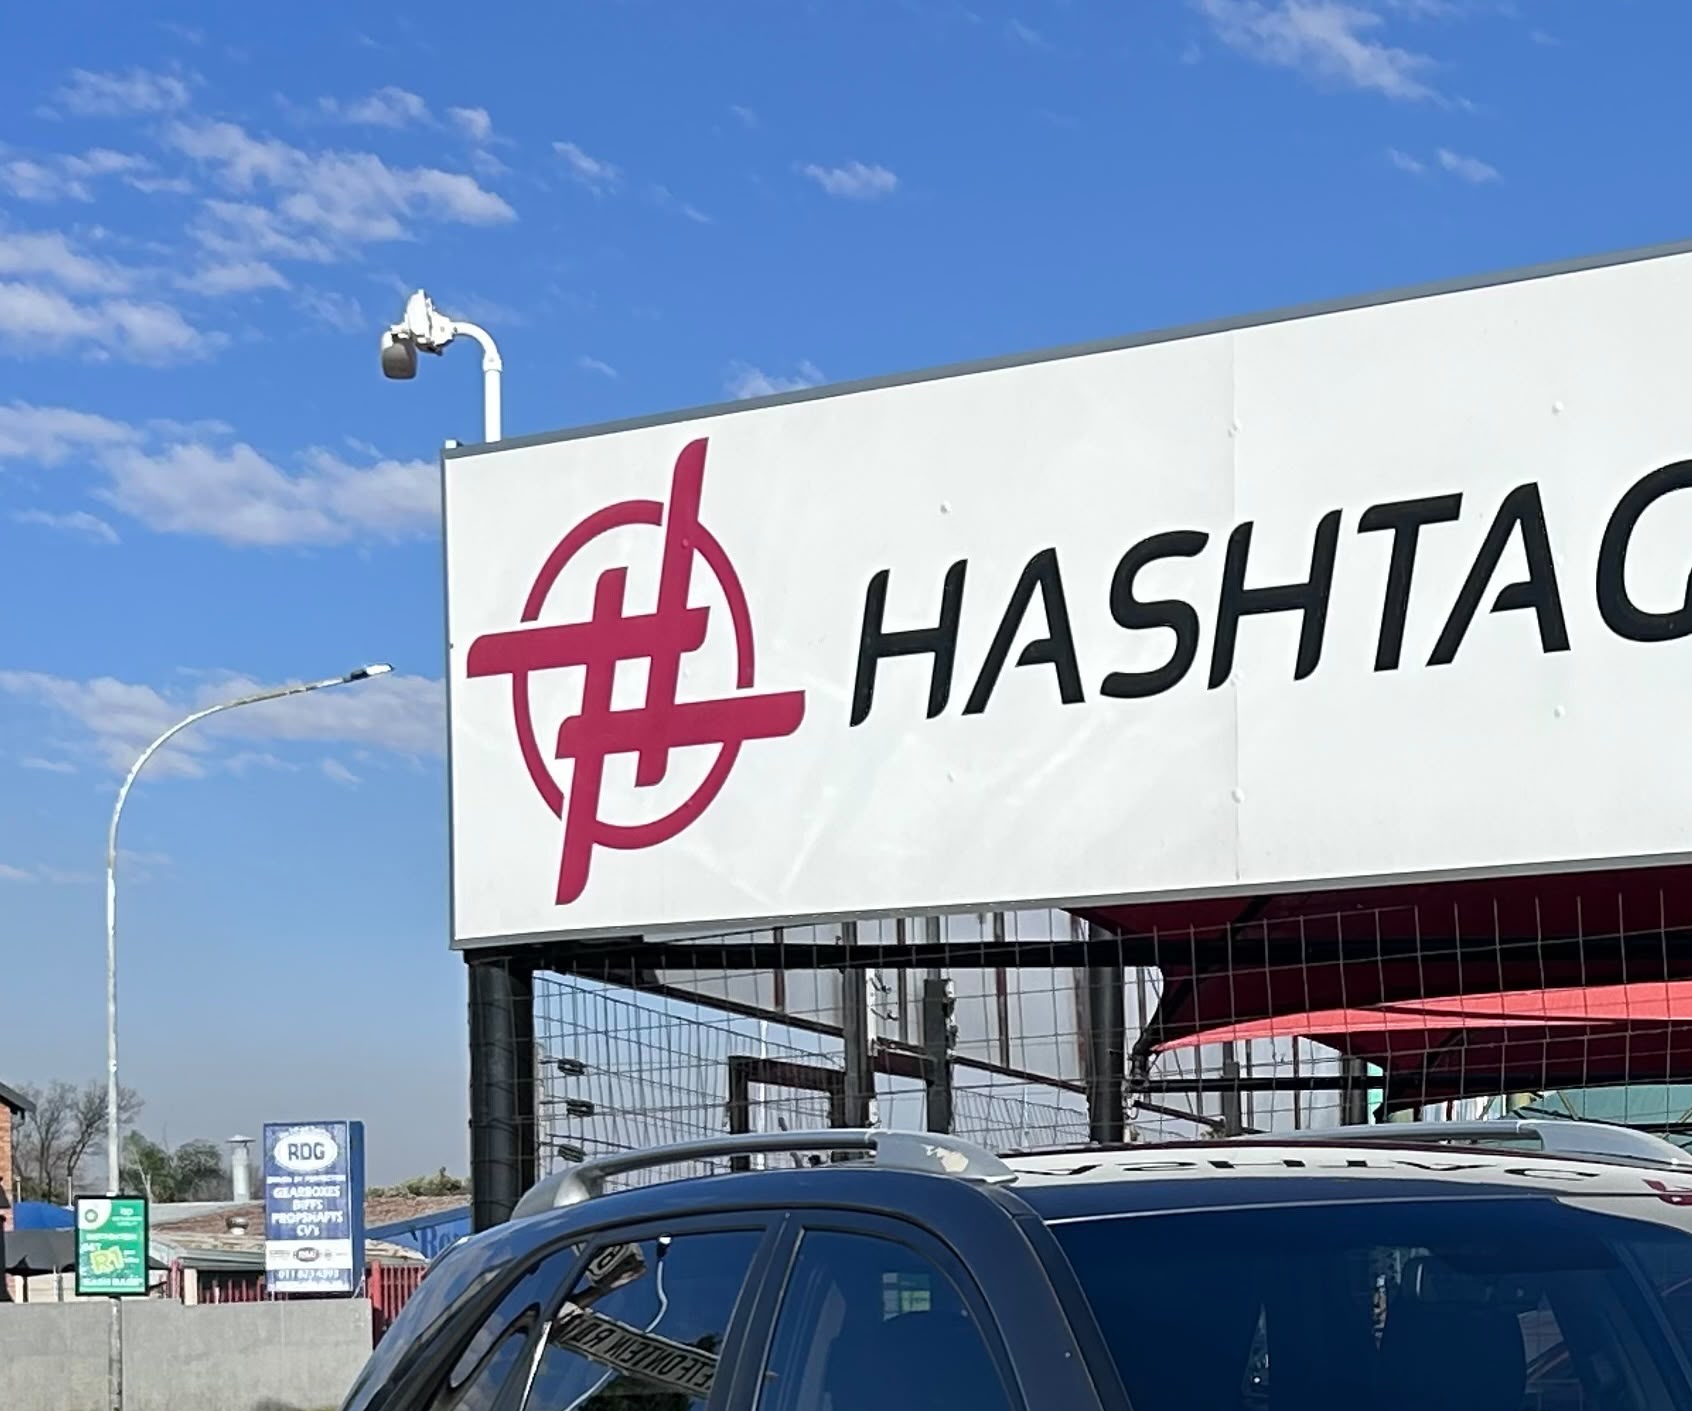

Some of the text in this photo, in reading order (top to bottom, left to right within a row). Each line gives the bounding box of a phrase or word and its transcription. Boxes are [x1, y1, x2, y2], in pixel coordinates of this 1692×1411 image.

[287, 1142, 326, 1161] RDG
[273, 1185, 341, 1199] GEARBOXES
[271, 1211, 344, 1225] PROPSHAFTS
